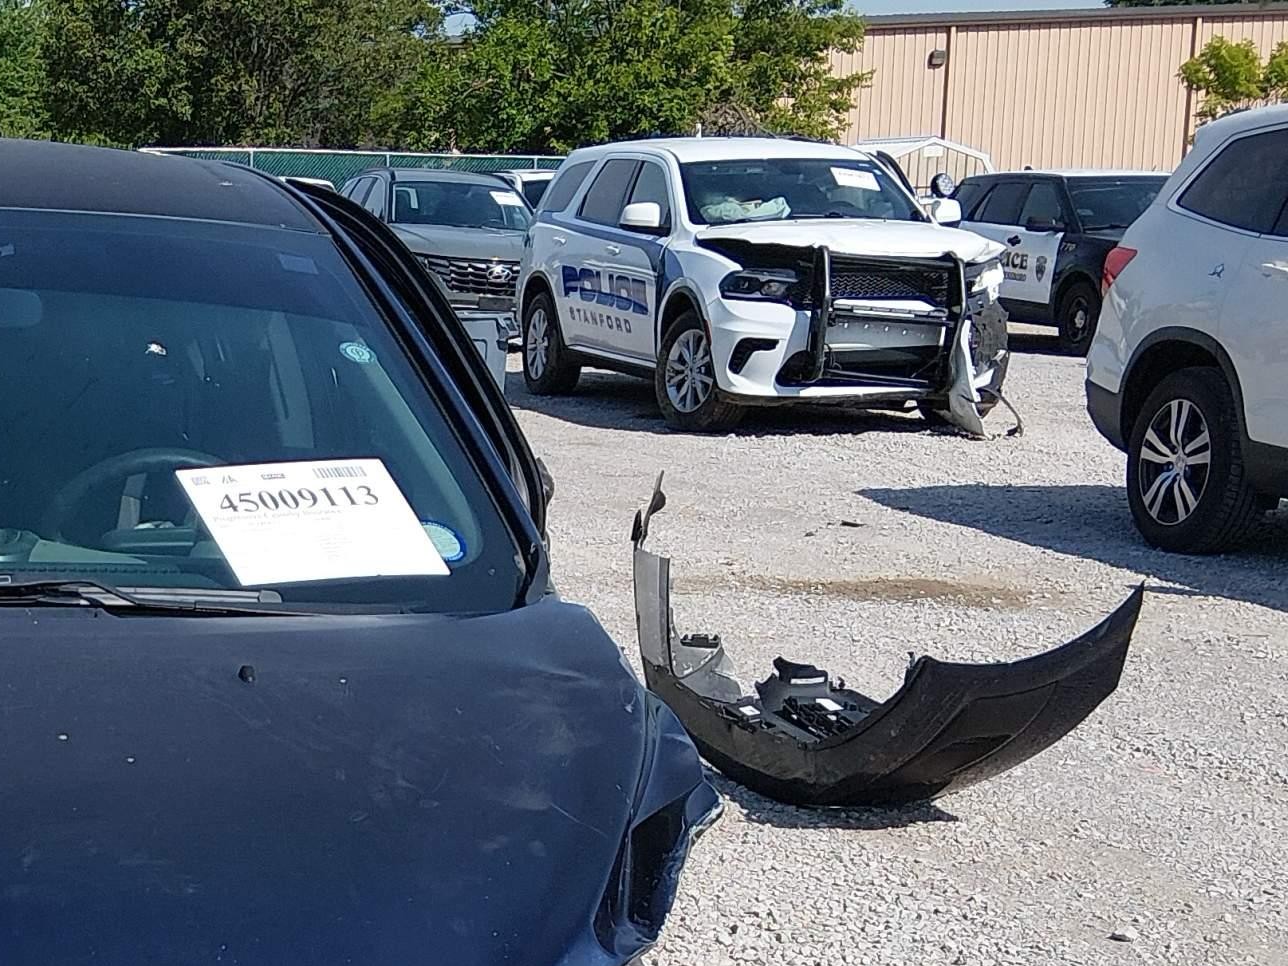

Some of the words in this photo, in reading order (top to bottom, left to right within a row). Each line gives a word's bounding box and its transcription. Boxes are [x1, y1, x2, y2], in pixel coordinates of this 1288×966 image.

[561, 264, 649, 315] POLICE
[569, 306, 632, 333] STANFORD
[219, 485, 379, 513] 45009113
